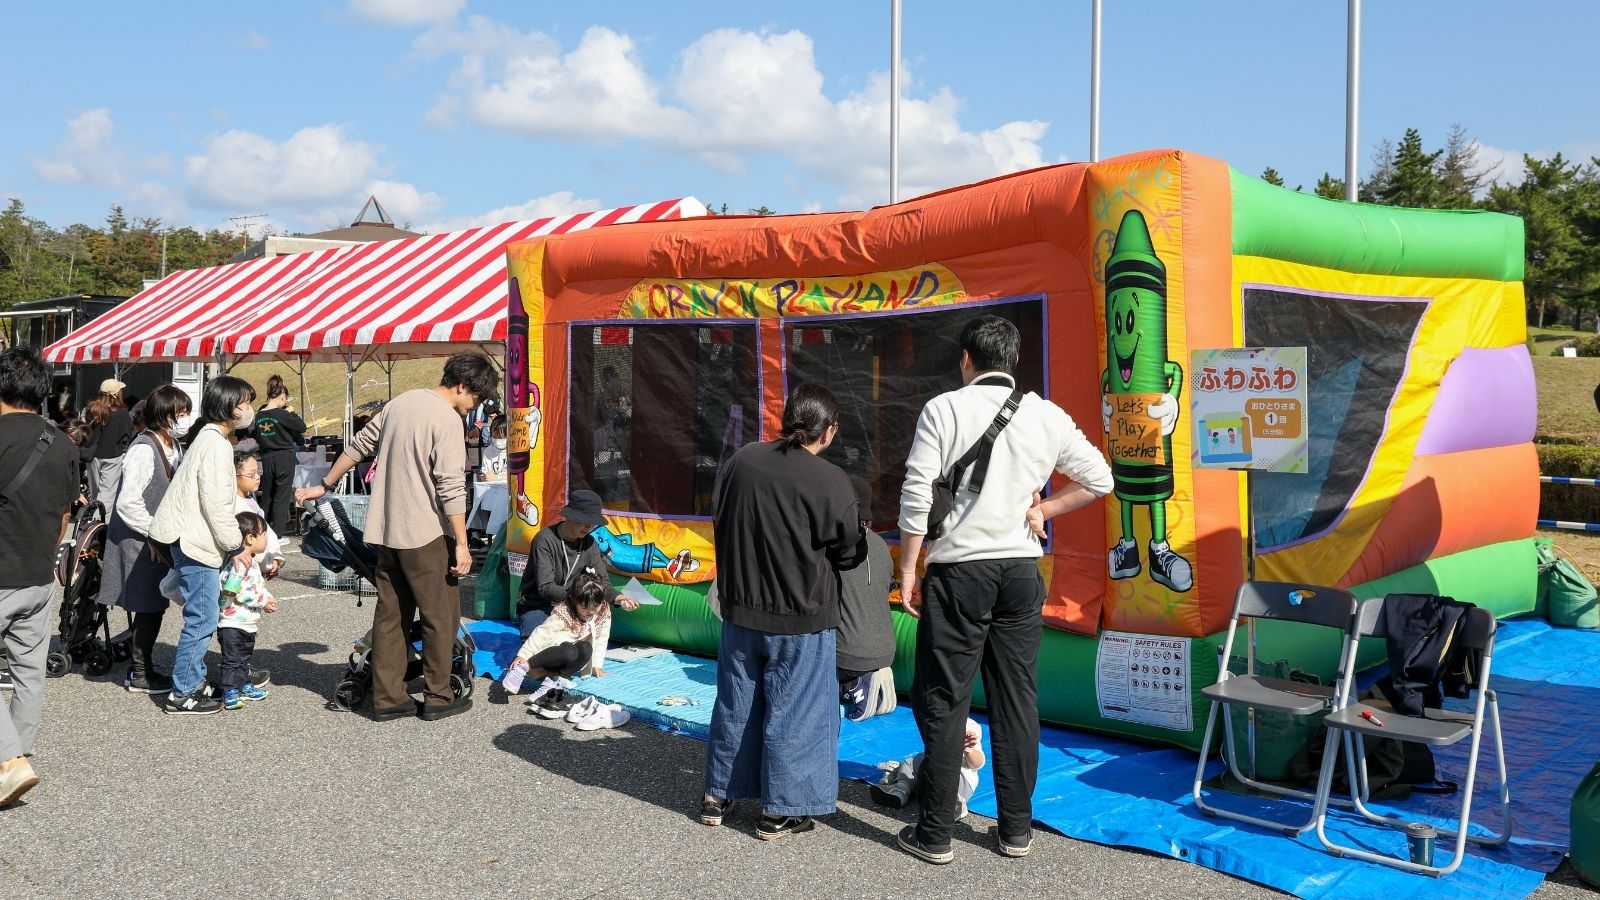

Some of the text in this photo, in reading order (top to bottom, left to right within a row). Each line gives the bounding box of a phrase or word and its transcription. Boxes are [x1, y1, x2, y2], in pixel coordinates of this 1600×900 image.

[649, 270, 940, 319] CRAYON PLAYLAND
[1199, 366, 1297, 391] ふわふわ
[1117, 397, 1144, 414] Let's
[1251, 402, 1296, 411] おひとりさま
[509, 425, 528, 437] Come
[1117, 417, 1147, 441] Play
[517, 437, 527, 448] in
[1160, 641, 1182, 649] RULES
[182, 697, 199, 711] N
